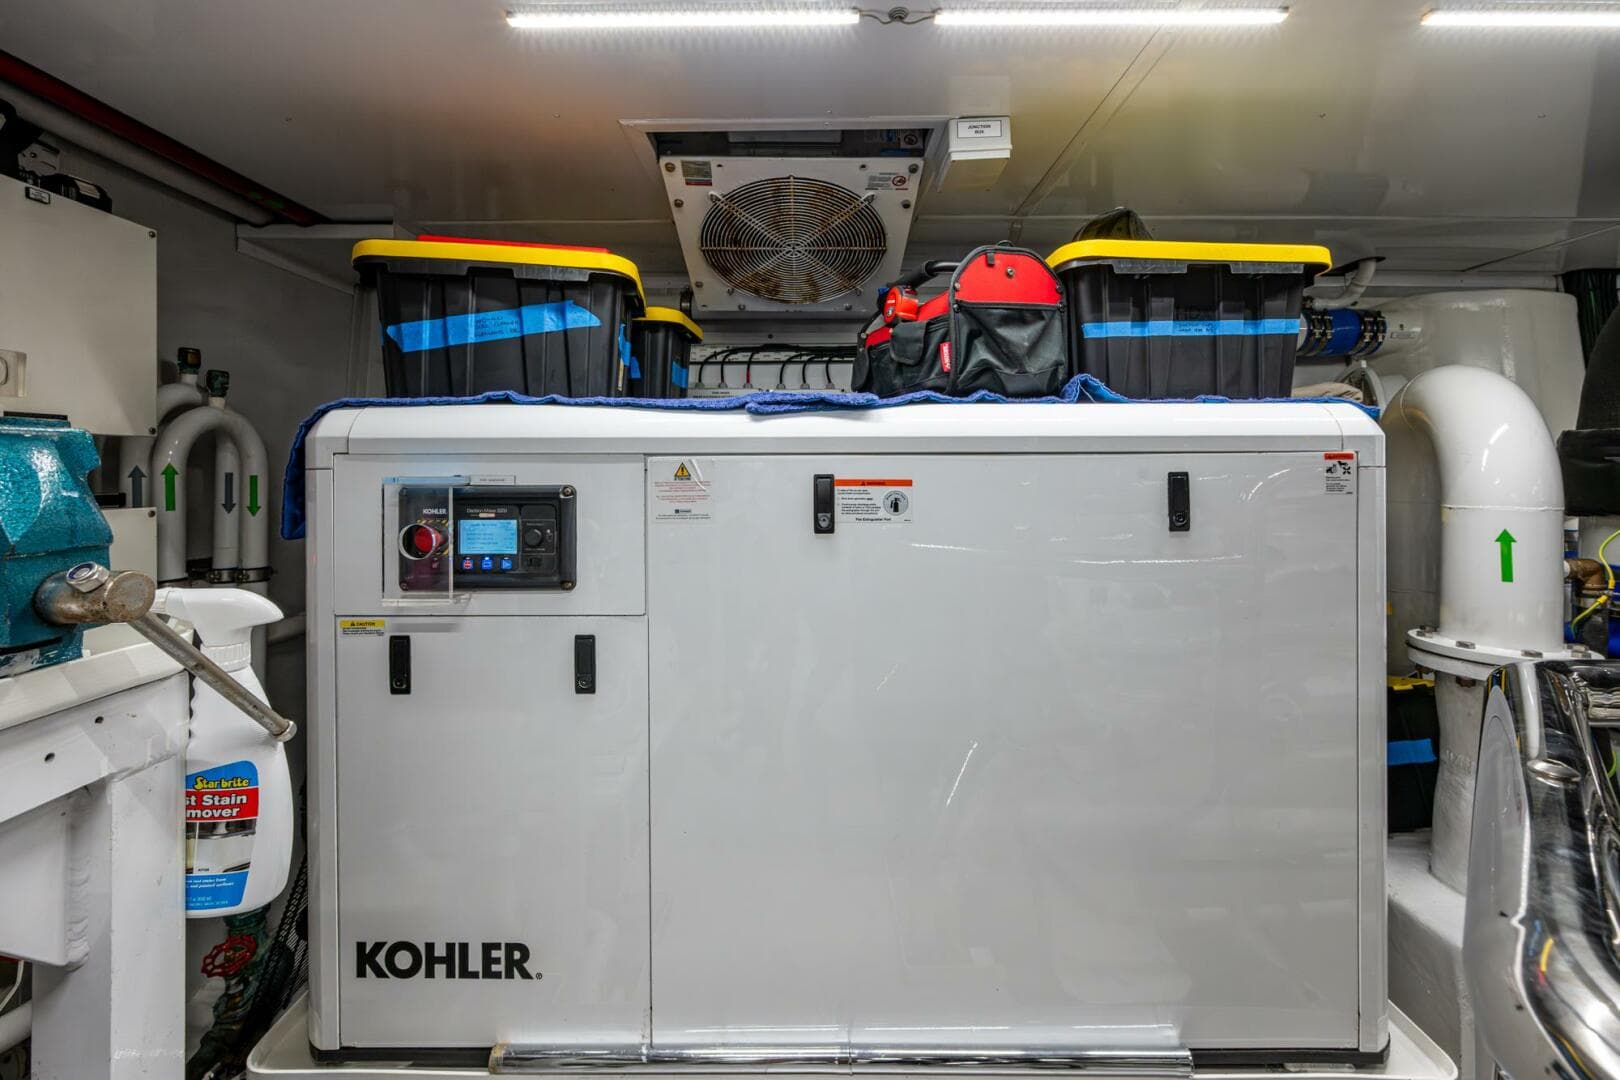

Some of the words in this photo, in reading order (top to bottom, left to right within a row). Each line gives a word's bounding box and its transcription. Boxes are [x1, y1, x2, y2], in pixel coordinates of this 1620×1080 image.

[186, 795, 197, 806] st
[202, 794, 248, 806] Stain
[186, 808, 240, 818] mover
[356, 941, 533, 979] KOHLER
